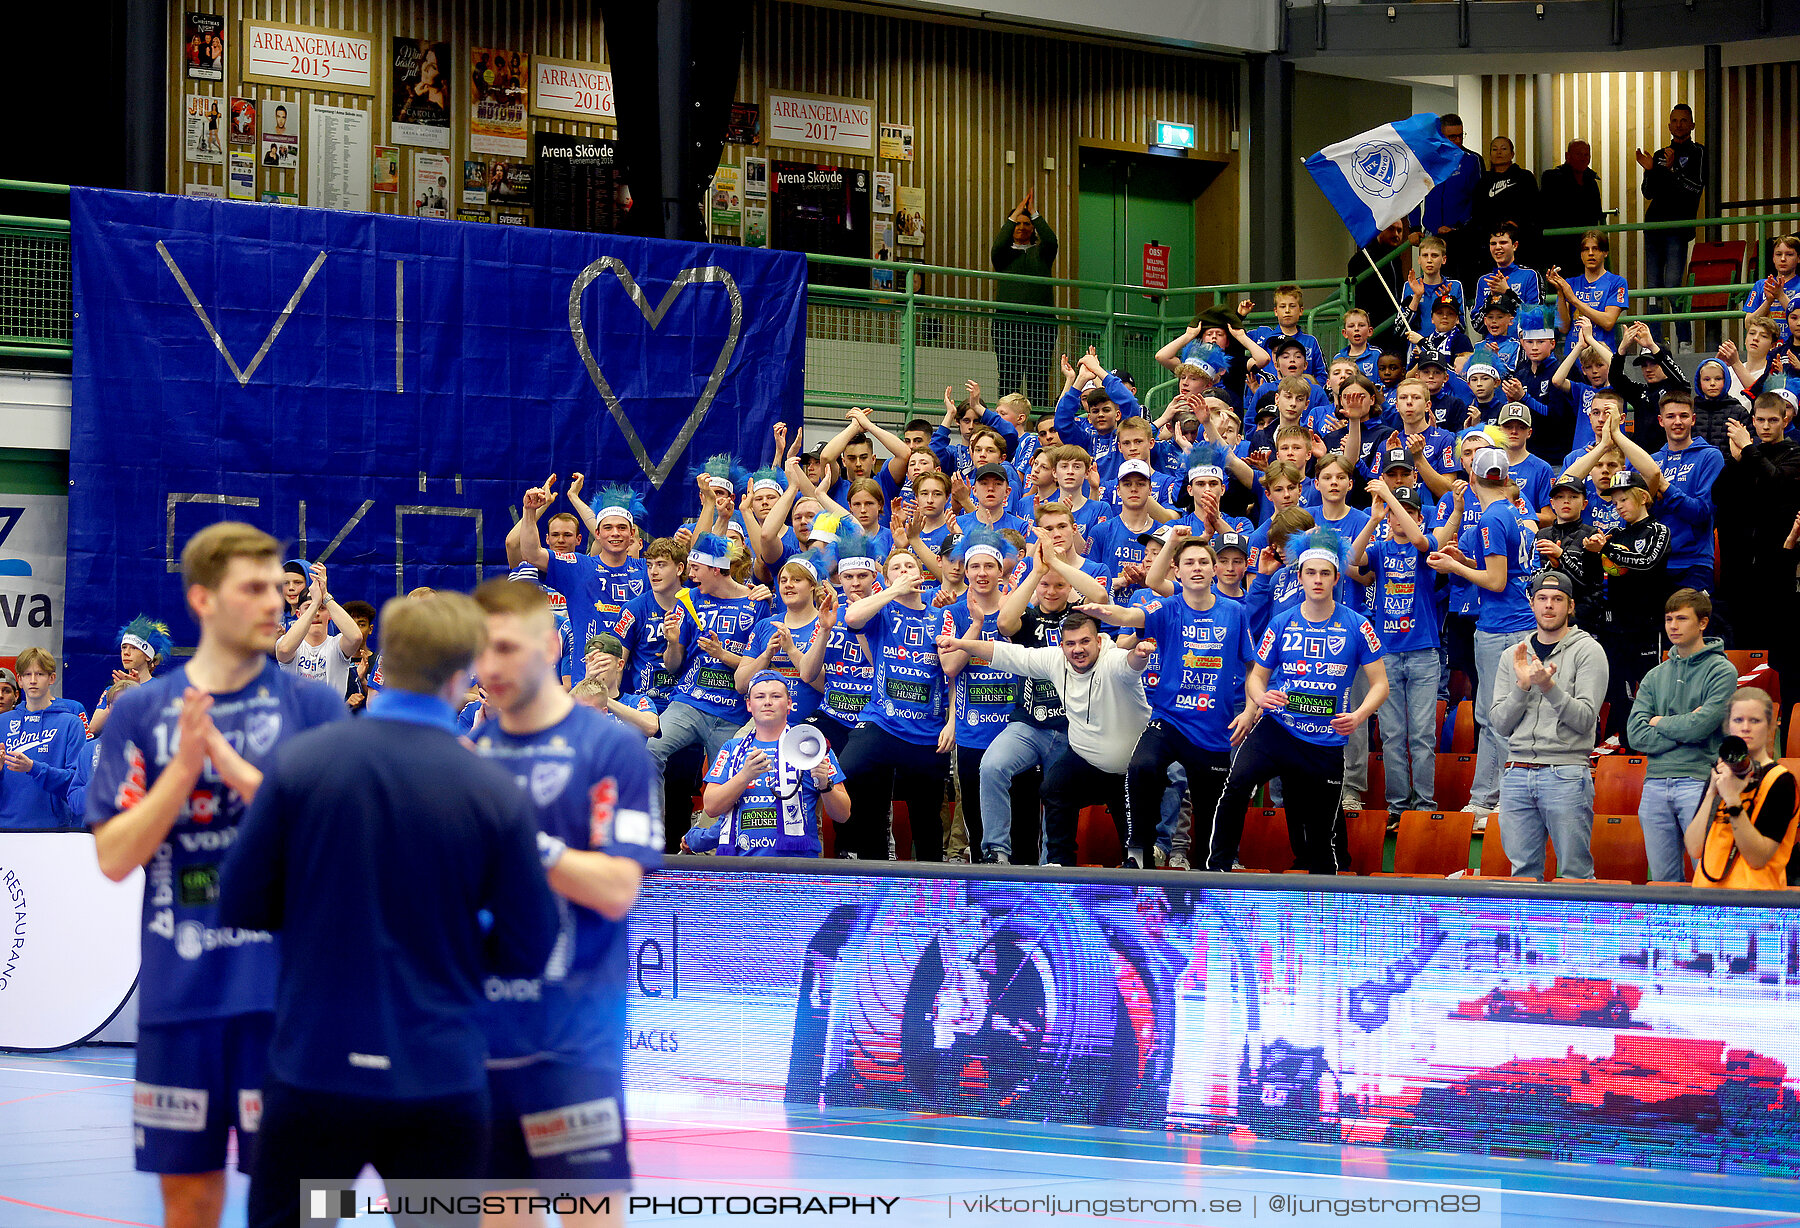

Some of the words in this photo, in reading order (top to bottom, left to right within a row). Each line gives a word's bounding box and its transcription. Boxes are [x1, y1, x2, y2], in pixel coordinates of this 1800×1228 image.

[253, 32, 367, 60] ARRANGEMANG
[290, 56, 330, 78] 2015
[540, 69, 612, 92] ARRANGEM
[574, 91, 611, 112] 2016
[478, 101, 523, 122] MOTOWN
[774, 101, 868, 125] ARRANGEMANG
[805, 122, 837, 141] 2017
[542, 145, 572, 158] Arena
[575, 144, 613, 157] Skövde
[570, 158, 600, 166] Evenemang
[1365, 160, 1378, 172] IFK
[778, 172, 805, 184] Arena
[807, 171, 842, 183] Skövde
[499, 216, 522, 224] SVERIGE
[1149, 248, 1162, 256] OBS!
[1463, 510, 1474, 521] 18
[1592, 507, 1603, 518] 56
[1115, 547, 1129, 558] 43
[1384, 556, 1396, 568] 28
[599, 578, 607, 591] 7
[1384, 597, 1414, 609] RAPP
[614, 608, 635, 638] MAXI
[893, 617, 903, 634] 7
[1384, 618, 1415, 630] DALOC
[645, 622, 664, 642] 24
[1034, 623, 1044, 640] 4
[1182, 625, 1196, 638] 39
[1361, 622, 1380, 650] MAXI
[826, 632, 845, 650] 22
[1258, 630, 1274, 658] MAXI
[1282, 632, 1303, 652] 22
[883, 646, 912, 659] DALOC
[298, 656, 311, 670] 29
[823, 662, 850, 675] DALOC
[1282, 662, 1312, 674] DALOC
[890, 665, 930, 678] VOLVO
[970, 672, 1013, 680] VOLVO
[1182, 670, 1218, 685] RAPP
[708, 679, 730, 688] HUSET
[832, 681, 872, 692] VOLVO
[887, 680, 927, 693] GRÖNSAKS
[1180, 684, 1216, 692] FASTIGHETER
[1292, 680, 1336, 690] VOLVO
[897, 690, 922, 699] HUSET
[970, 687, 1013, 695] GRÖNSAKS
[830, 692, 870, 705] GRÖNSAKS
[980, 694, 1007, 702] HUSET
[1176, 695, 1215, 709] DALOC
[1289, 694, 1333, 707] GRÖNSAKS
[838, 702, 863, 712] HUSET
[1300, 704, 1327, 714] HUSET
[895, 708, 928, 720] SKÖVDE
[1296, 722, 1334, 734] SKÖVDE
[5, 728, 58, 754] Salming
[710, 750, 728, 776] MAXI
[751, 838, 776, 848] SKÖV
[626, 1029, 678, 1052] LACES
